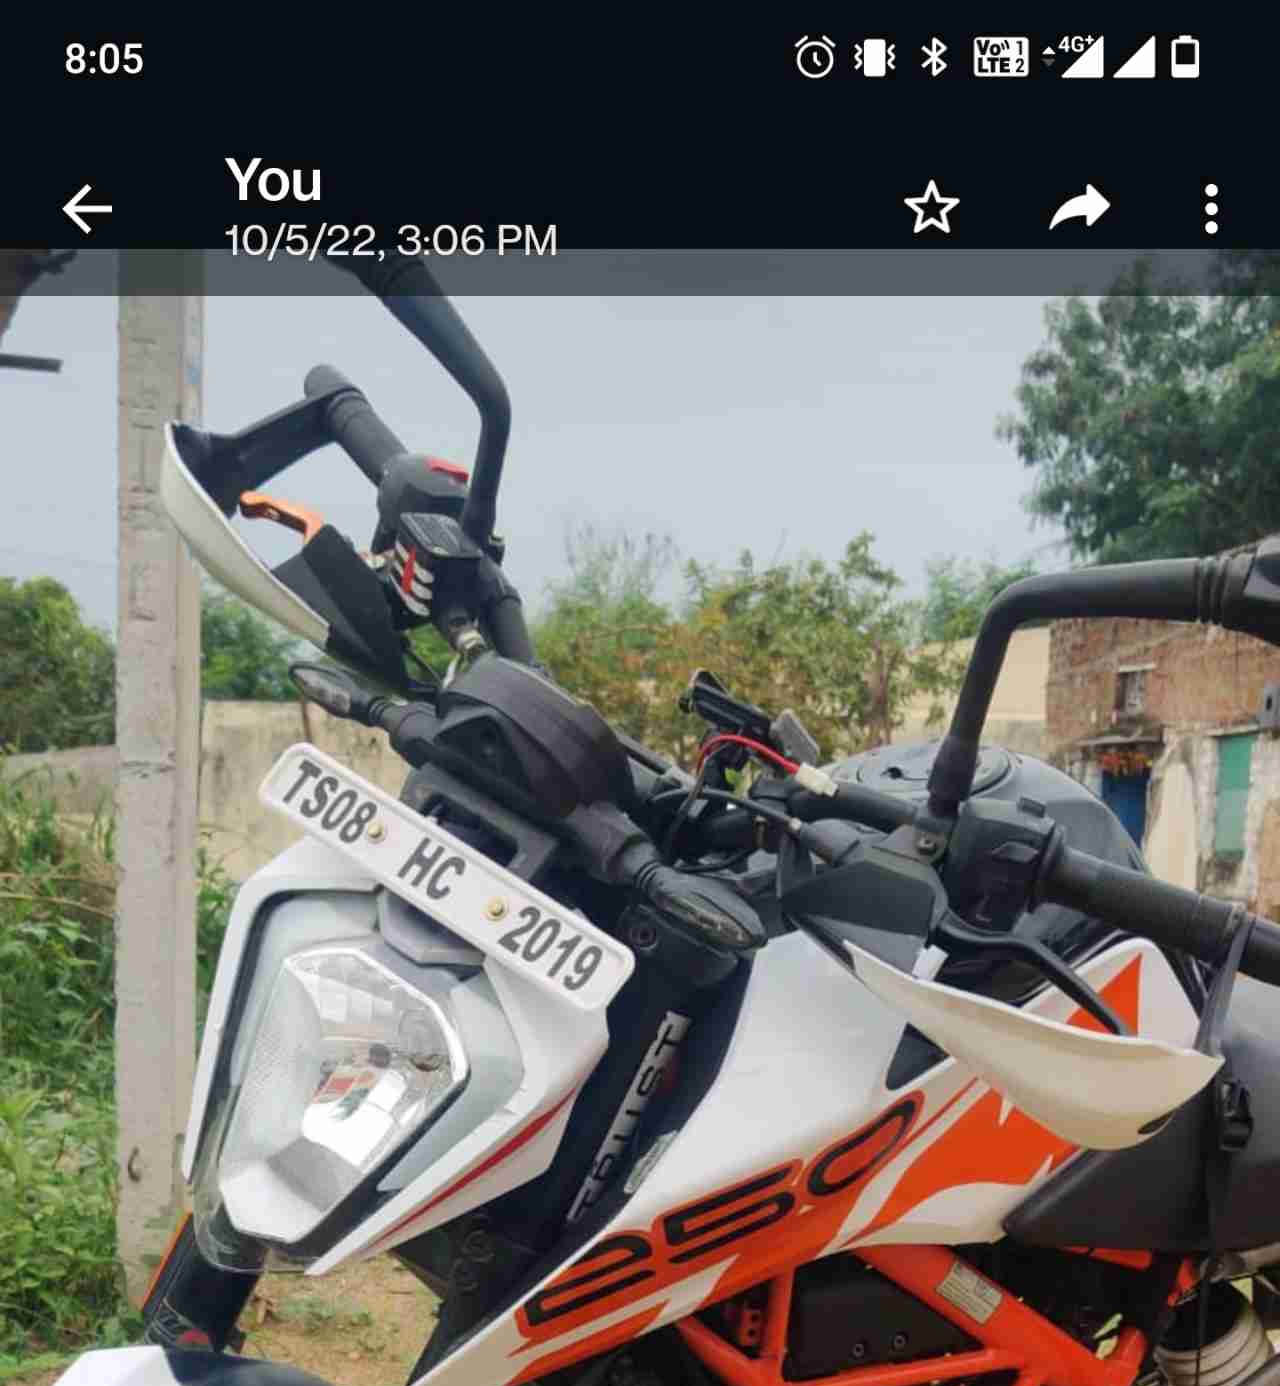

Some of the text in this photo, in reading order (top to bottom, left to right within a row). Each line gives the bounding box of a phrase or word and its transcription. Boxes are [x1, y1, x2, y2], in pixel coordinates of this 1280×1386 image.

[65, 43, 144, 75] 8:05
[977, 57, 1011, 73] LTE
[225, 157, 322, 202] You
[226, 223, 559, 262] 10/5/22, 3:06 PM
[282, 760, 603, 992] TS08 HC 2019
[521, 1099, 918, 1327] 250
